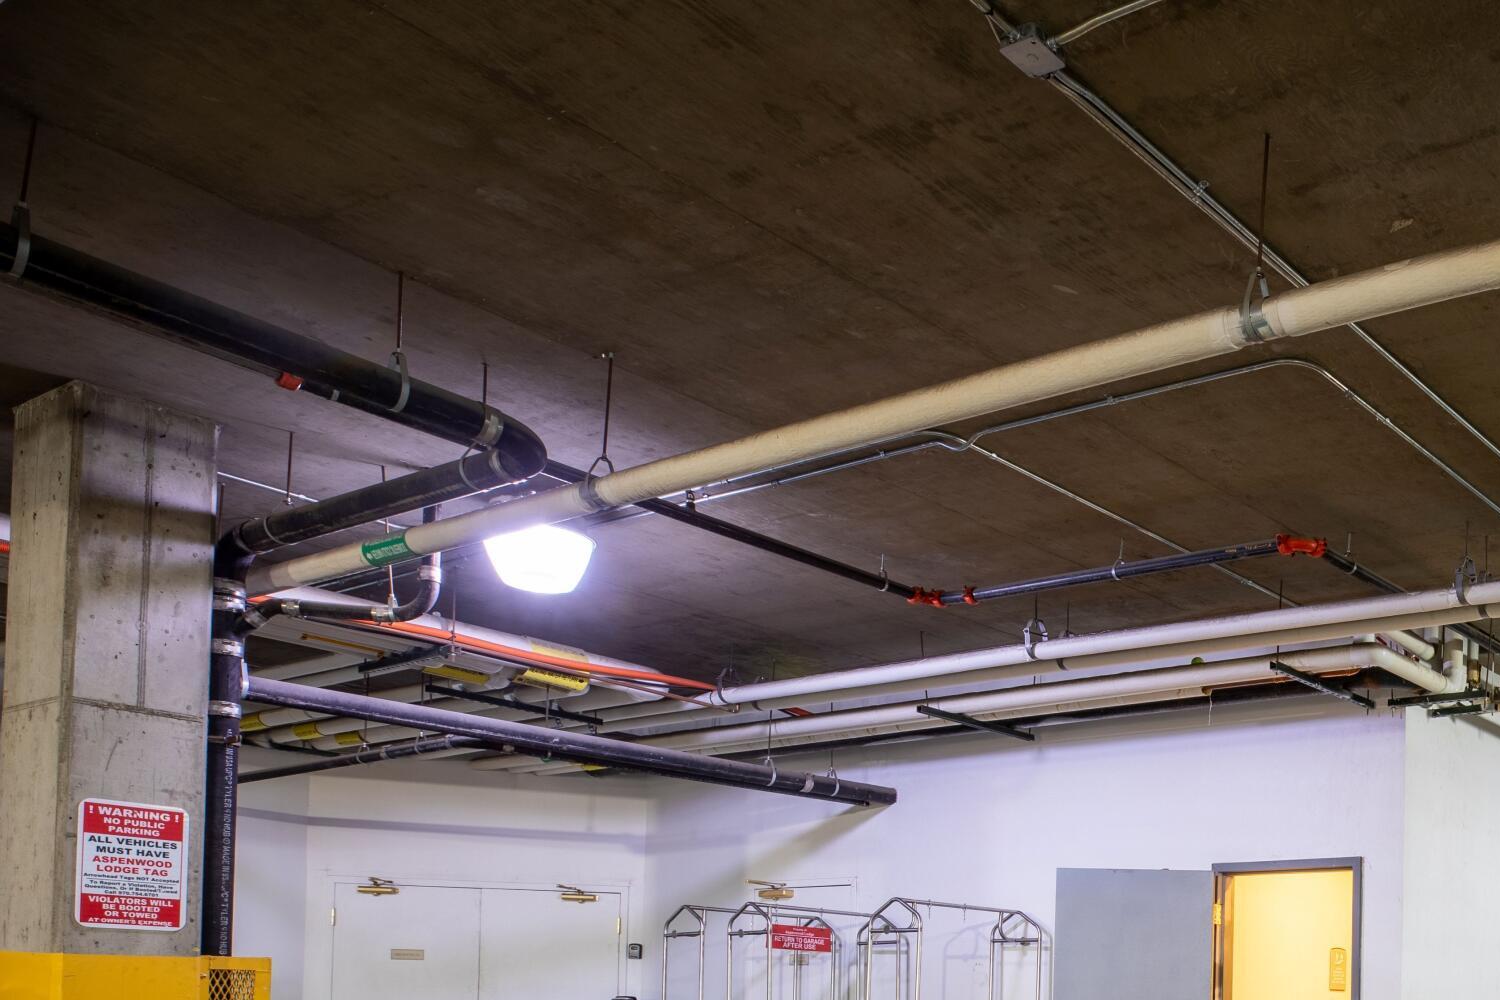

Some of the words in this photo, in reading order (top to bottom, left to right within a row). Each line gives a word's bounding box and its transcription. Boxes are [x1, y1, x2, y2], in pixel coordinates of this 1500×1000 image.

[98, 806, 170, 822] WARNING
[103, 817, 120, 825] NO
[124, 819, 165, 830] PUBLIC
[108, 825, 160, 837] PARKING
[88, 835, 112, 844] ALL
[116, 837, 178, 850] VEHICLES
[96, 845, 132, 855] MUST
[136, 849, 170, 859] HAVE
[92, 855, 172, 868] ASPENWOOD
[96, 864, 139, 875] LODGE
[144, 868, 168, 877] TAG
[88, 895, 147, 906] VIOLATORS
[150, 899, 174, 908] WILL
[119, 904, 160, 913] BOOTED
[122, 911, 158, 919] TOWED
[774, 935, 795, 943] RETURN
